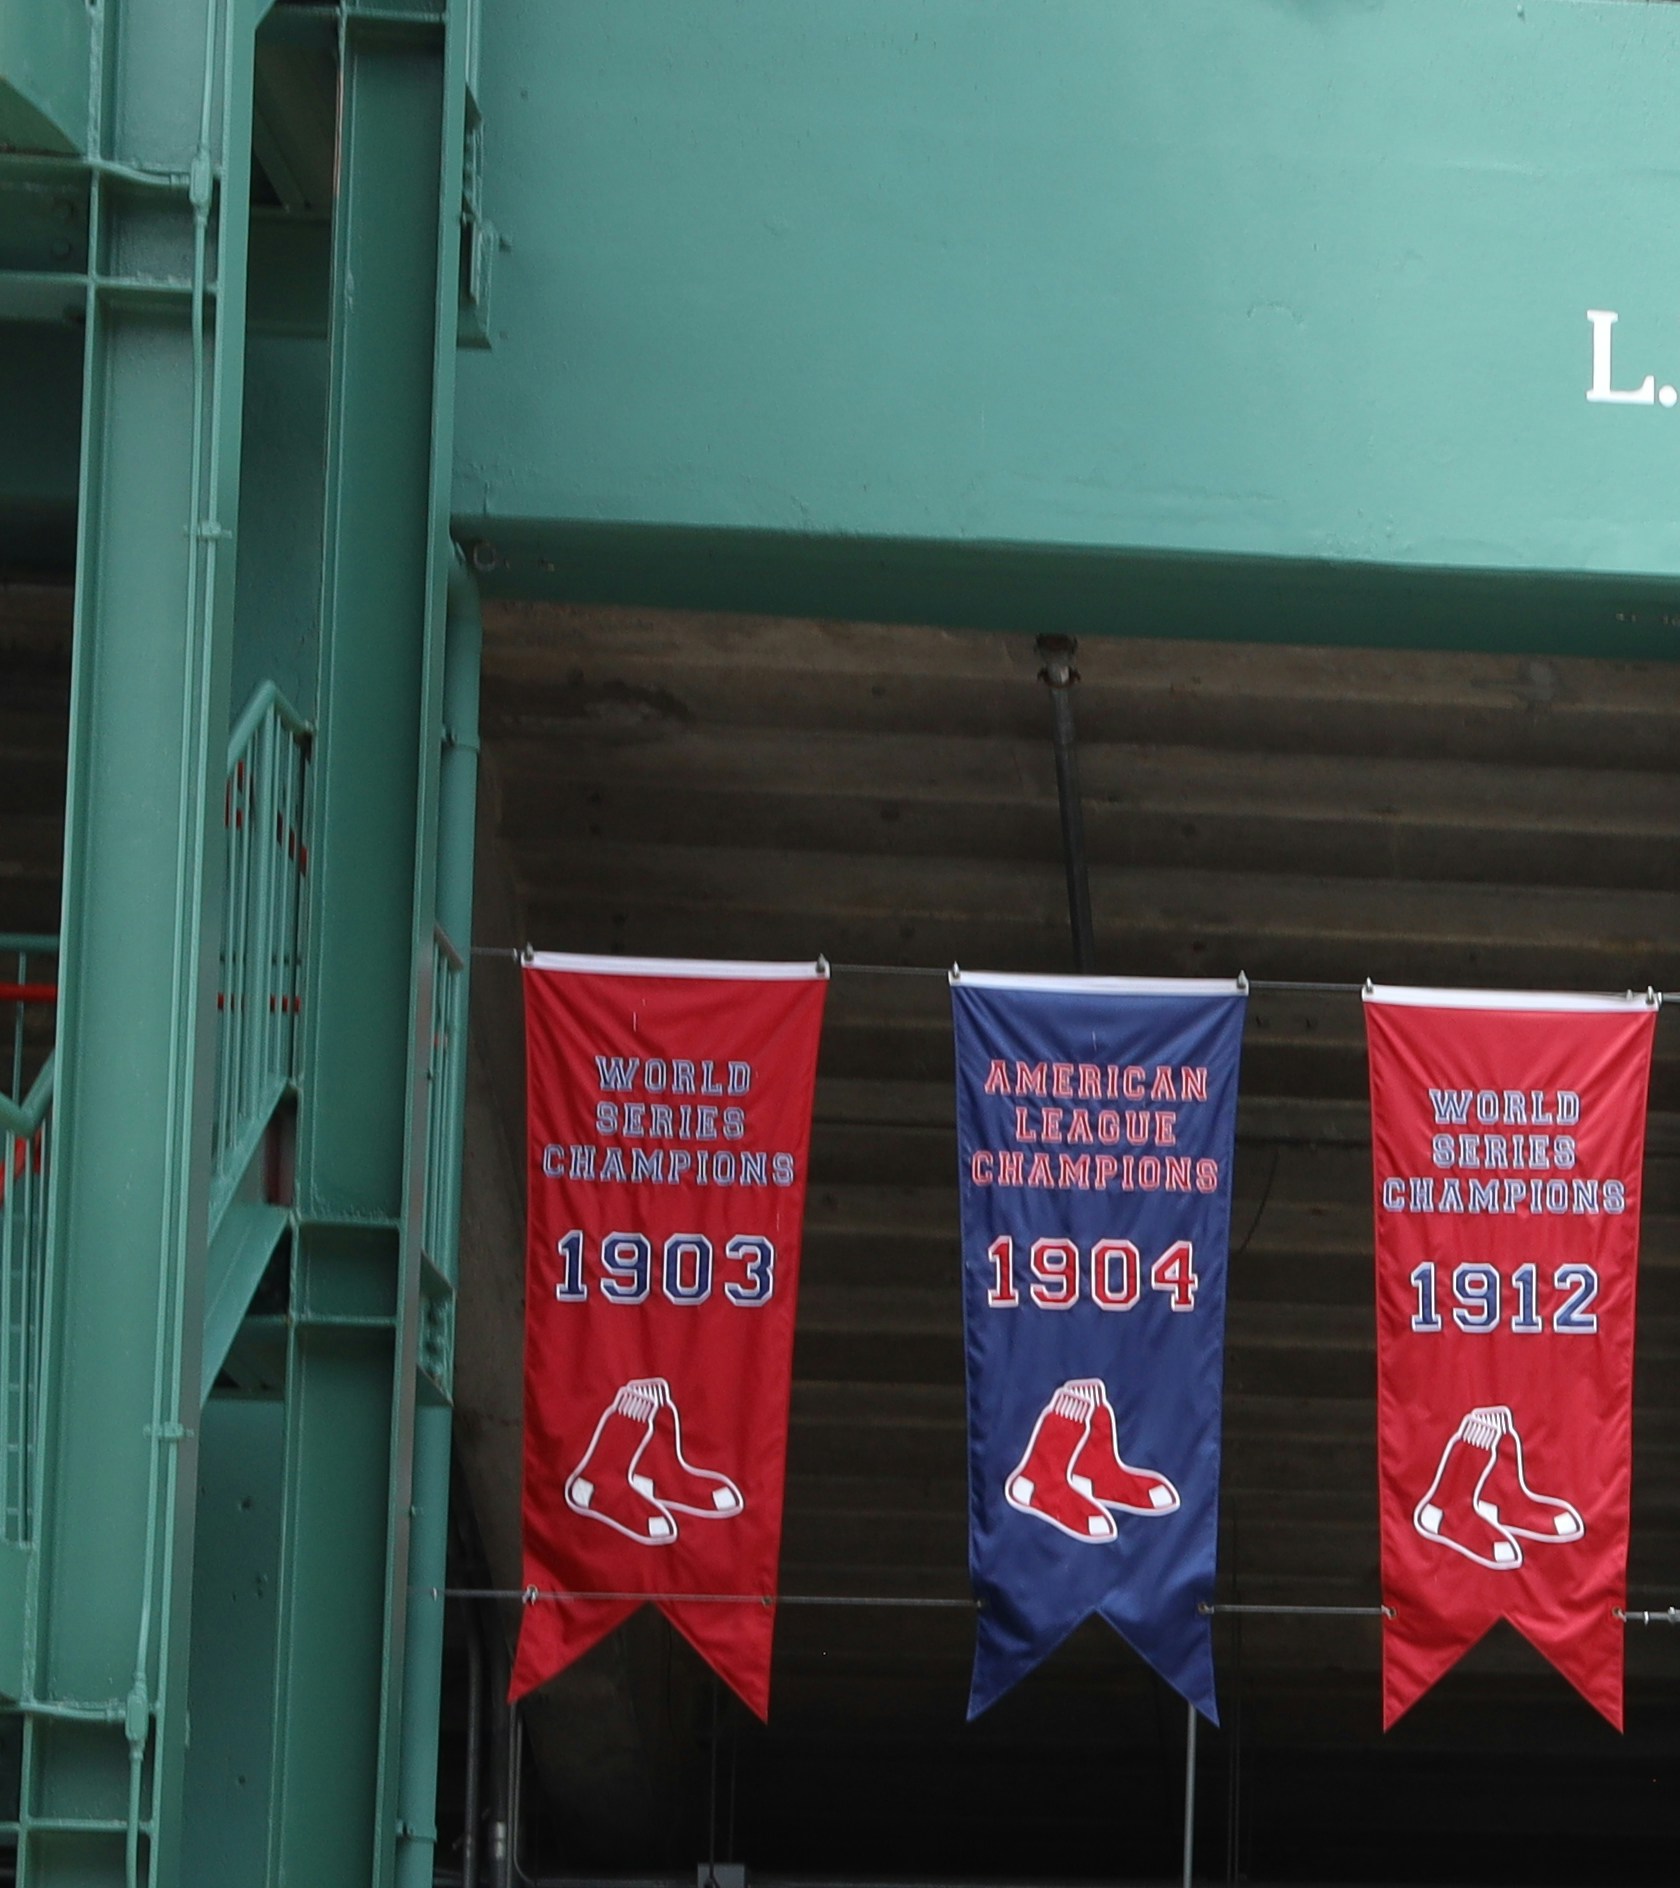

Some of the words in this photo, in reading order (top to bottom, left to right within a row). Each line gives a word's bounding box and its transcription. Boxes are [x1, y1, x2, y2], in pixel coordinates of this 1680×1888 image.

[595, 1056, 750, 1097] WORLD
[984, 1060, 1208, 1101] AMERICAN
[596, 1102, 746, 1139] SERIES
[1016, 1107, 1177, 1147] LEAGUE
[1428, 1089, 1581, 1126] WORLD
[542, 1144, 794, 1187] CHAMPIONS
[971, 1150, 1219, 1193] CHAMPIONS
[1432, 1134, 1576, 1169] SERIES
[1382, 1177, 1626, 1214] CHAMPIONS
[556, 1230, 774, 1306] 1903
[987, 1236, 1197, 1312] 1904
[1410, 1262, 1599, 1333] 1912
